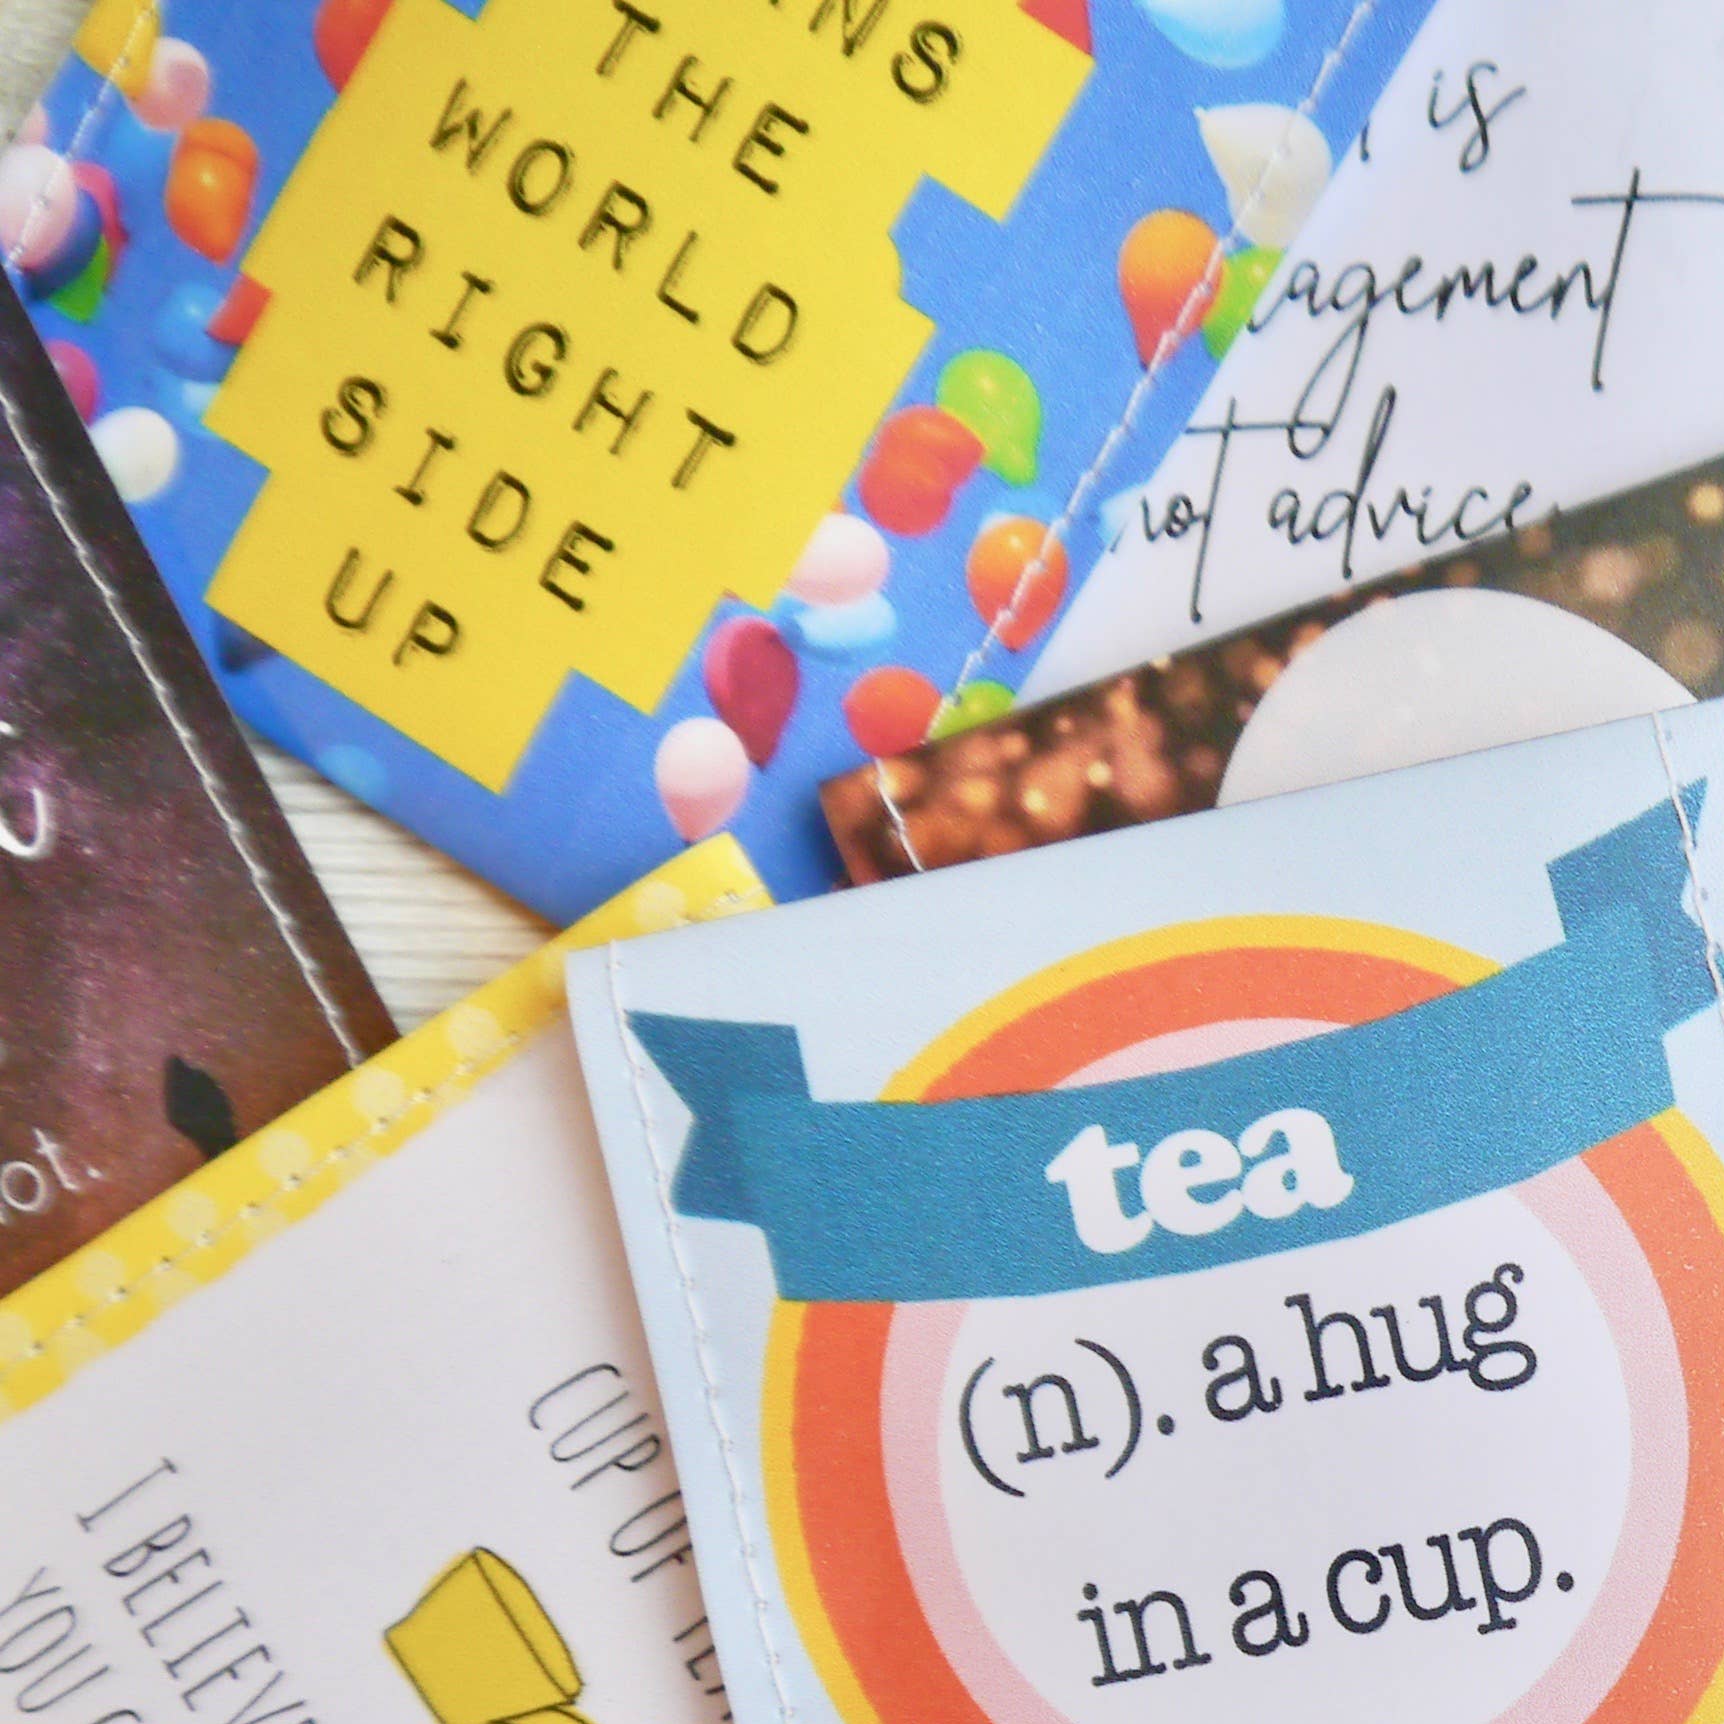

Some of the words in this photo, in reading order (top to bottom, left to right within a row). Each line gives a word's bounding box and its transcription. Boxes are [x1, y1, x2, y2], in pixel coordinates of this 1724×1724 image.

[595, 0, 810, 195] THE
[770, 0, 962, 103] NS
[1427, 61, 1526, 174] is
[428, 79, 801, 366] WORLD
[353, 214, 736, 490] RIGHT
[321, 376, 614, 612] SIDE
[323, 547, 461, 667] UP
[0, 1123, 105, 1224] ot.
[1046, 1106, 1355, 1254] tea
[529, 1364, 660, 1490] CUP
[959, 1339, 1176, 1497] (n).
[1204, 1336, 1281, 1422] a
[1285, 1262, 1537, 1400] hug
[76, 1457, 177, 1532] I
[1078, 1583, 1211, 1686] in
[1229, 1570, 1308, 1656] a
[1327, 1516, 1575, 1634] cup.
